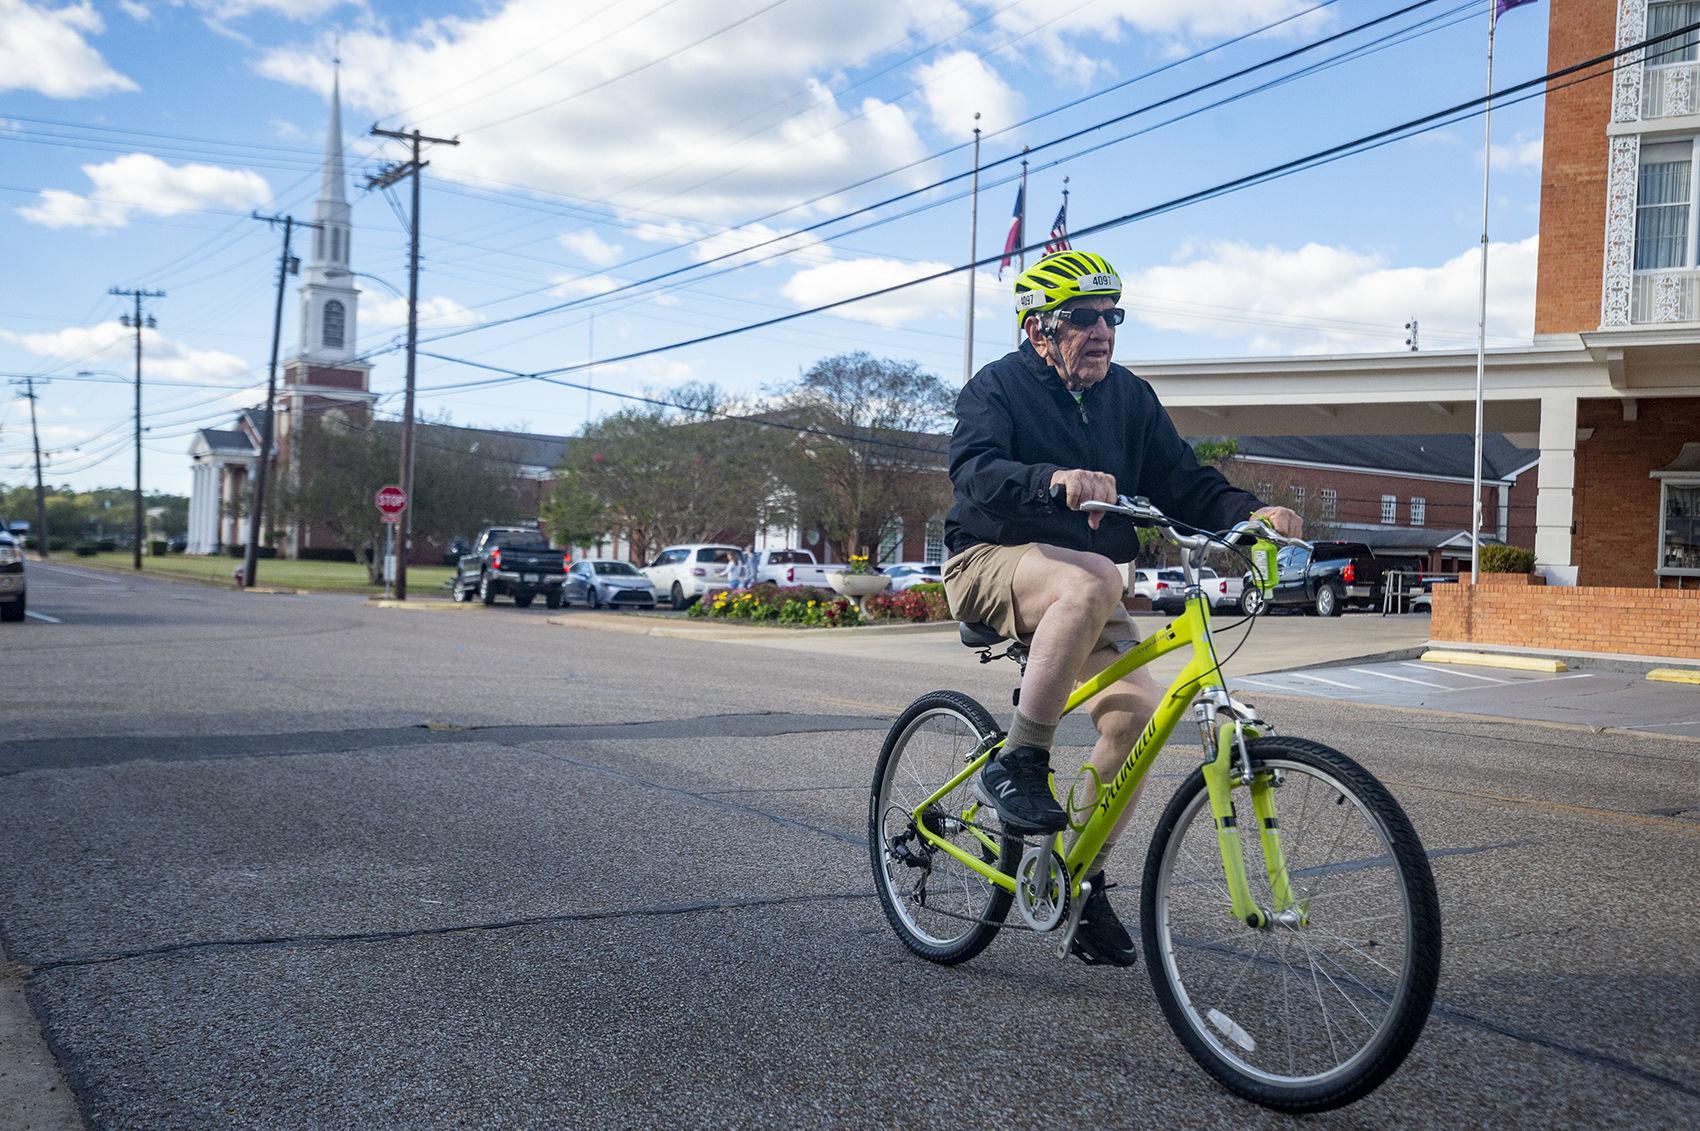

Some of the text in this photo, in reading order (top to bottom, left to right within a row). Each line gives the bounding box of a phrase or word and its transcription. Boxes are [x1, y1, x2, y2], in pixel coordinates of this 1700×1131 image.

[1092, 275, 1112, 286] 4097
[1020, 294, 1034, 306] 4097
[377, 494, 406, 507] STOP
[995, 779, 1017, 799] N
